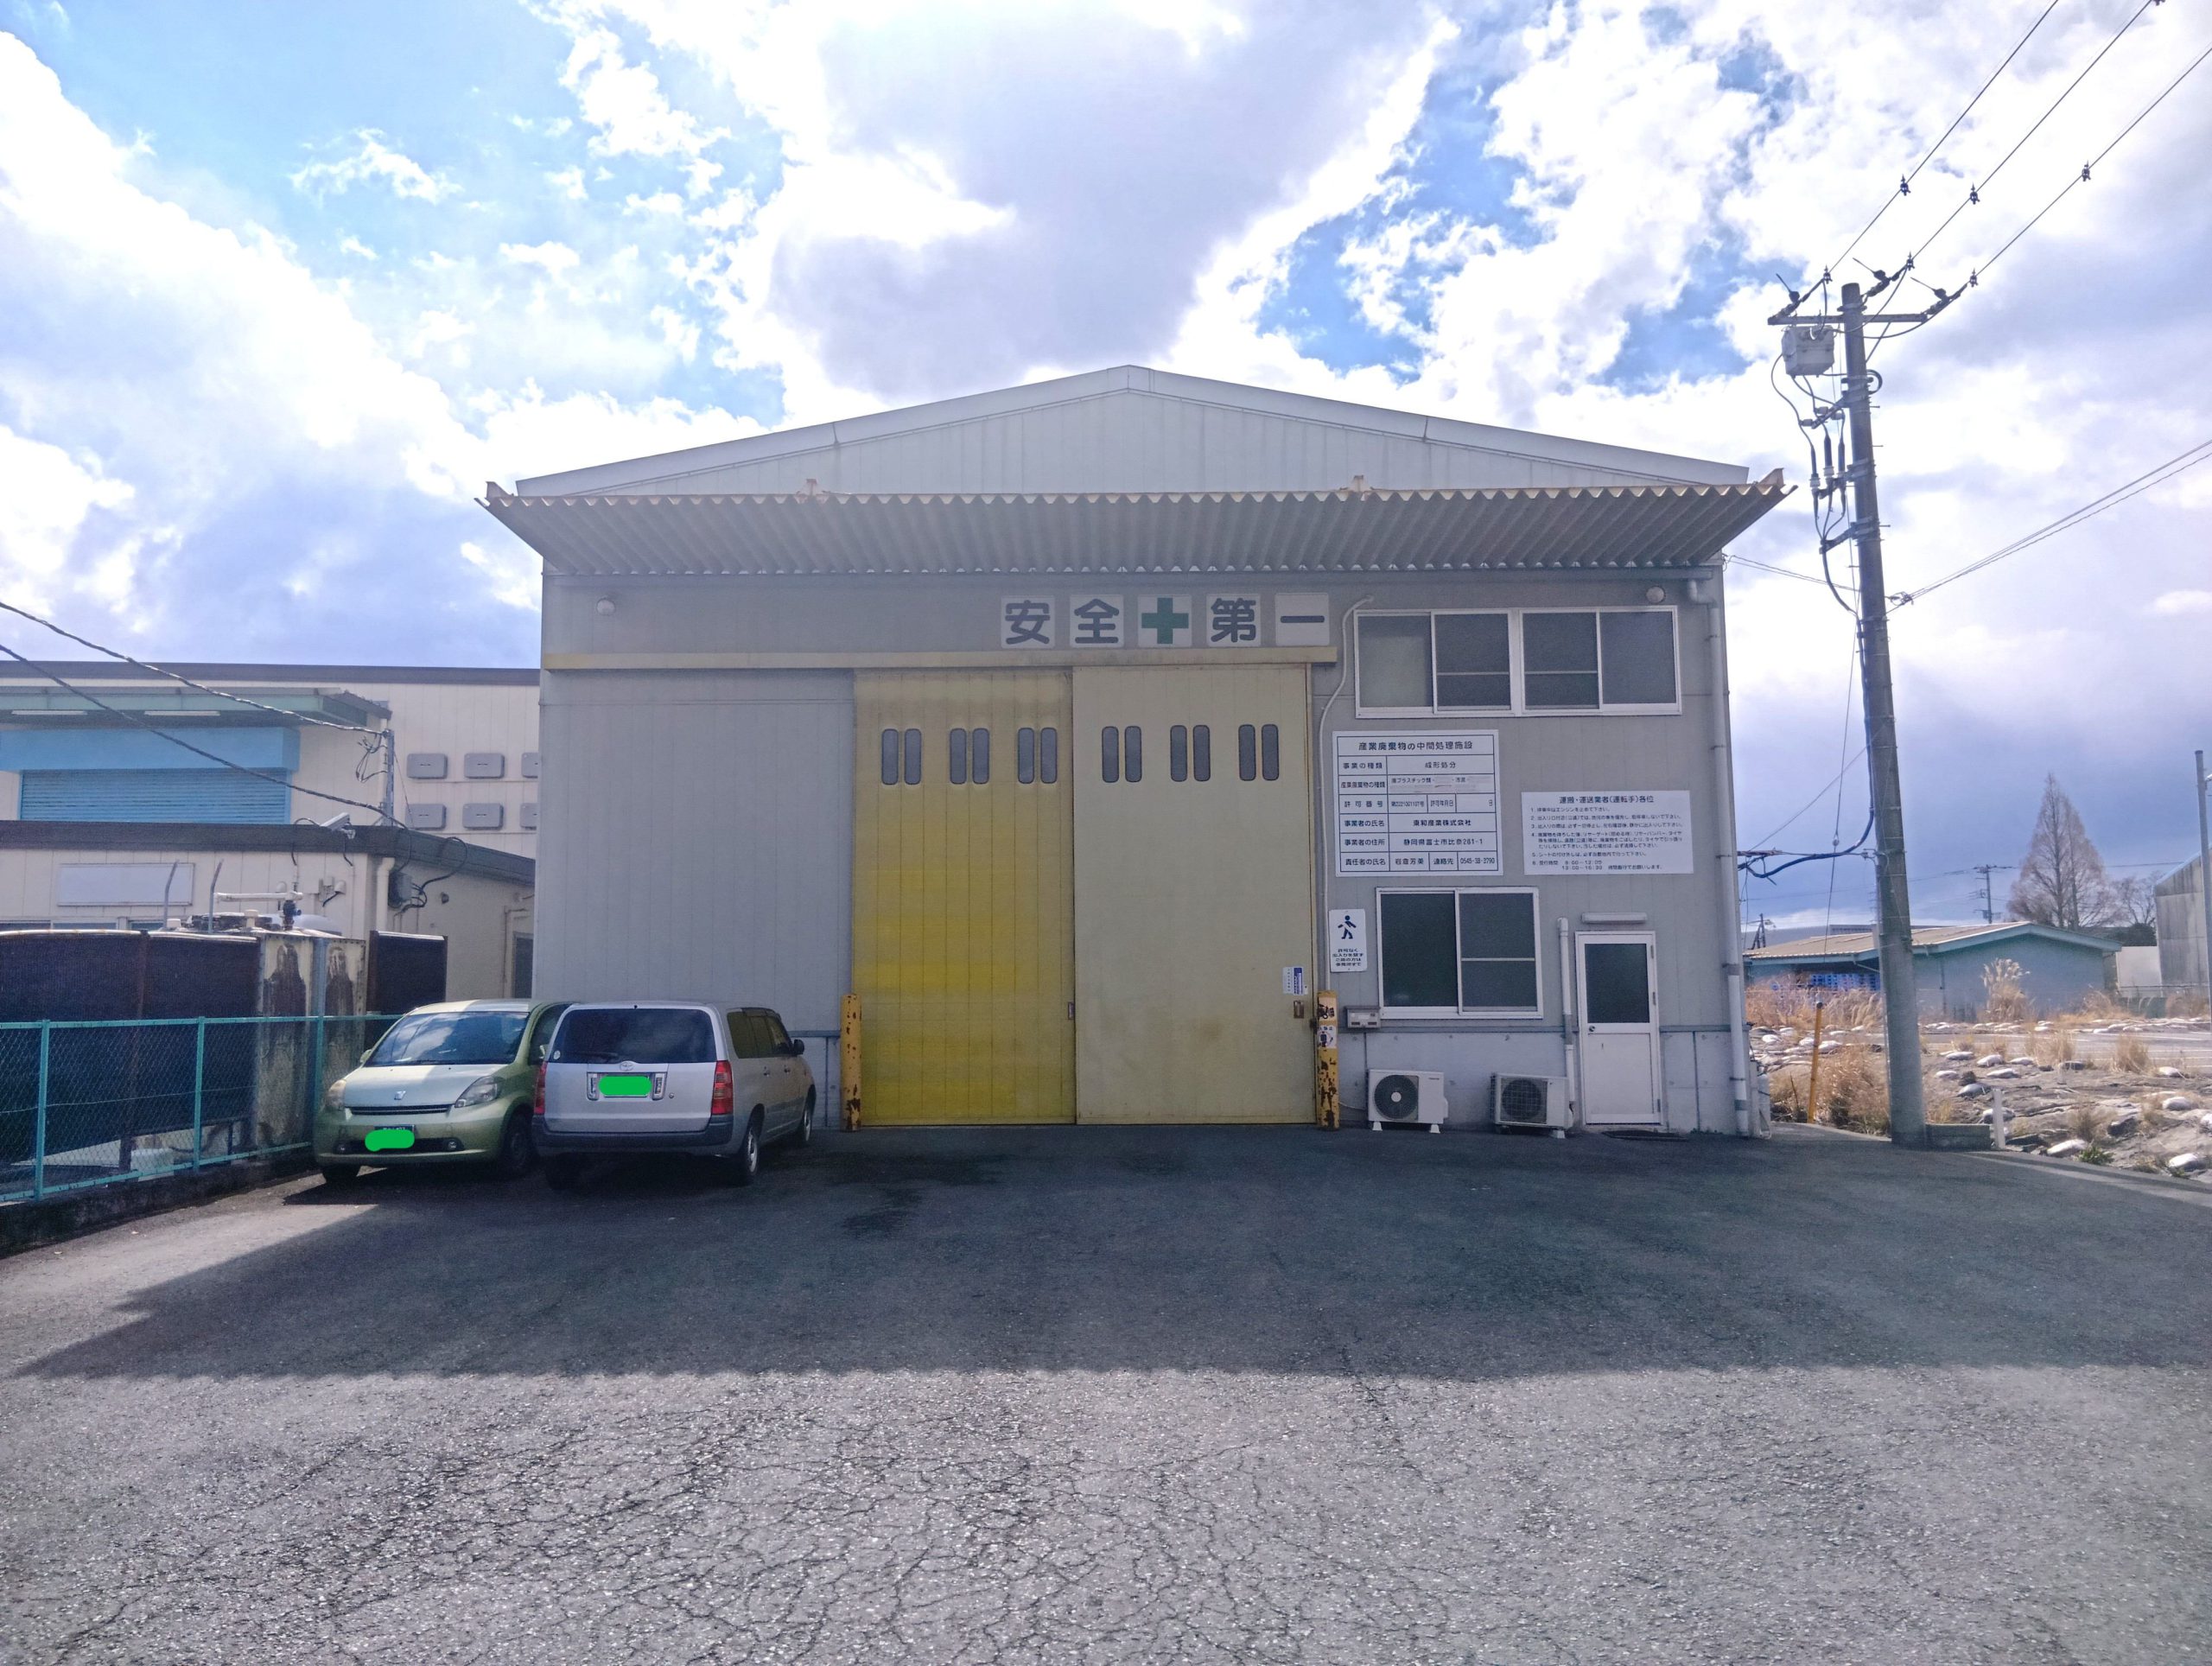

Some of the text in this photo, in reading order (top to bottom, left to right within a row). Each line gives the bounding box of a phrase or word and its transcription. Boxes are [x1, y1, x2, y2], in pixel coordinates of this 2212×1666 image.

[1358, 741, 1473, 751] 産業廃棄物の中間処理施設
